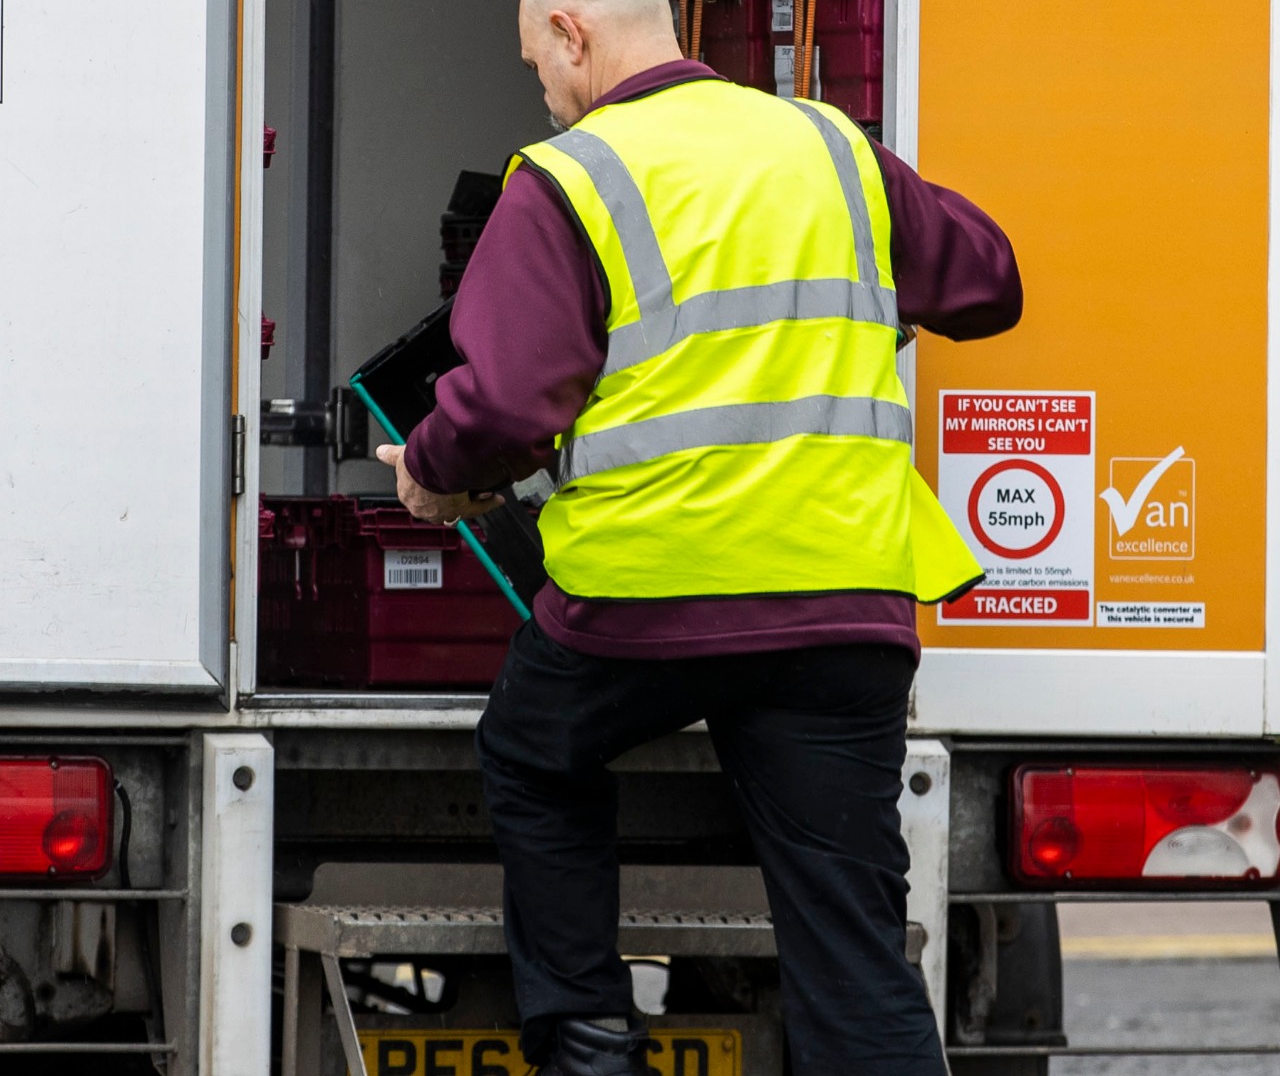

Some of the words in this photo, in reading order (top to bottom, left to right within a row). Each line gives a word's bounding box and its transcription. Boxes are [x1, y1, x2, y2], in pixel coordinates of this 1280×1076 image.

[958, 398, 970, 412] IF
[973, 398, 1003, 412] YOU
[1006, 398, 1048, 413] CAN'T
[1051, 399, 1076, 413] SEE
[945, 418, 968, 431] MY
[971, 418, 1035, 432] MIRRORS
[1038, 418, 1042, 432] I
[1045, 418, 1088, 432] CAN'T
[988, 437, 1013, 451] SEE
[1015, 437, 1045, 451] YOU
[996, 488, 1036, 504] MAX
[988, 512, 1044, 530] 55mph
[1116, 538, 1188, 552] excellence
[1006, 567, 1031, 575] limited
[1045, 567, 1072, 576] 55mph
[1048, 579, 1089, 587] emissions
[974, 596, 1057, 614] TRACKED
[1116, 606, 1150, 615] catalytic
